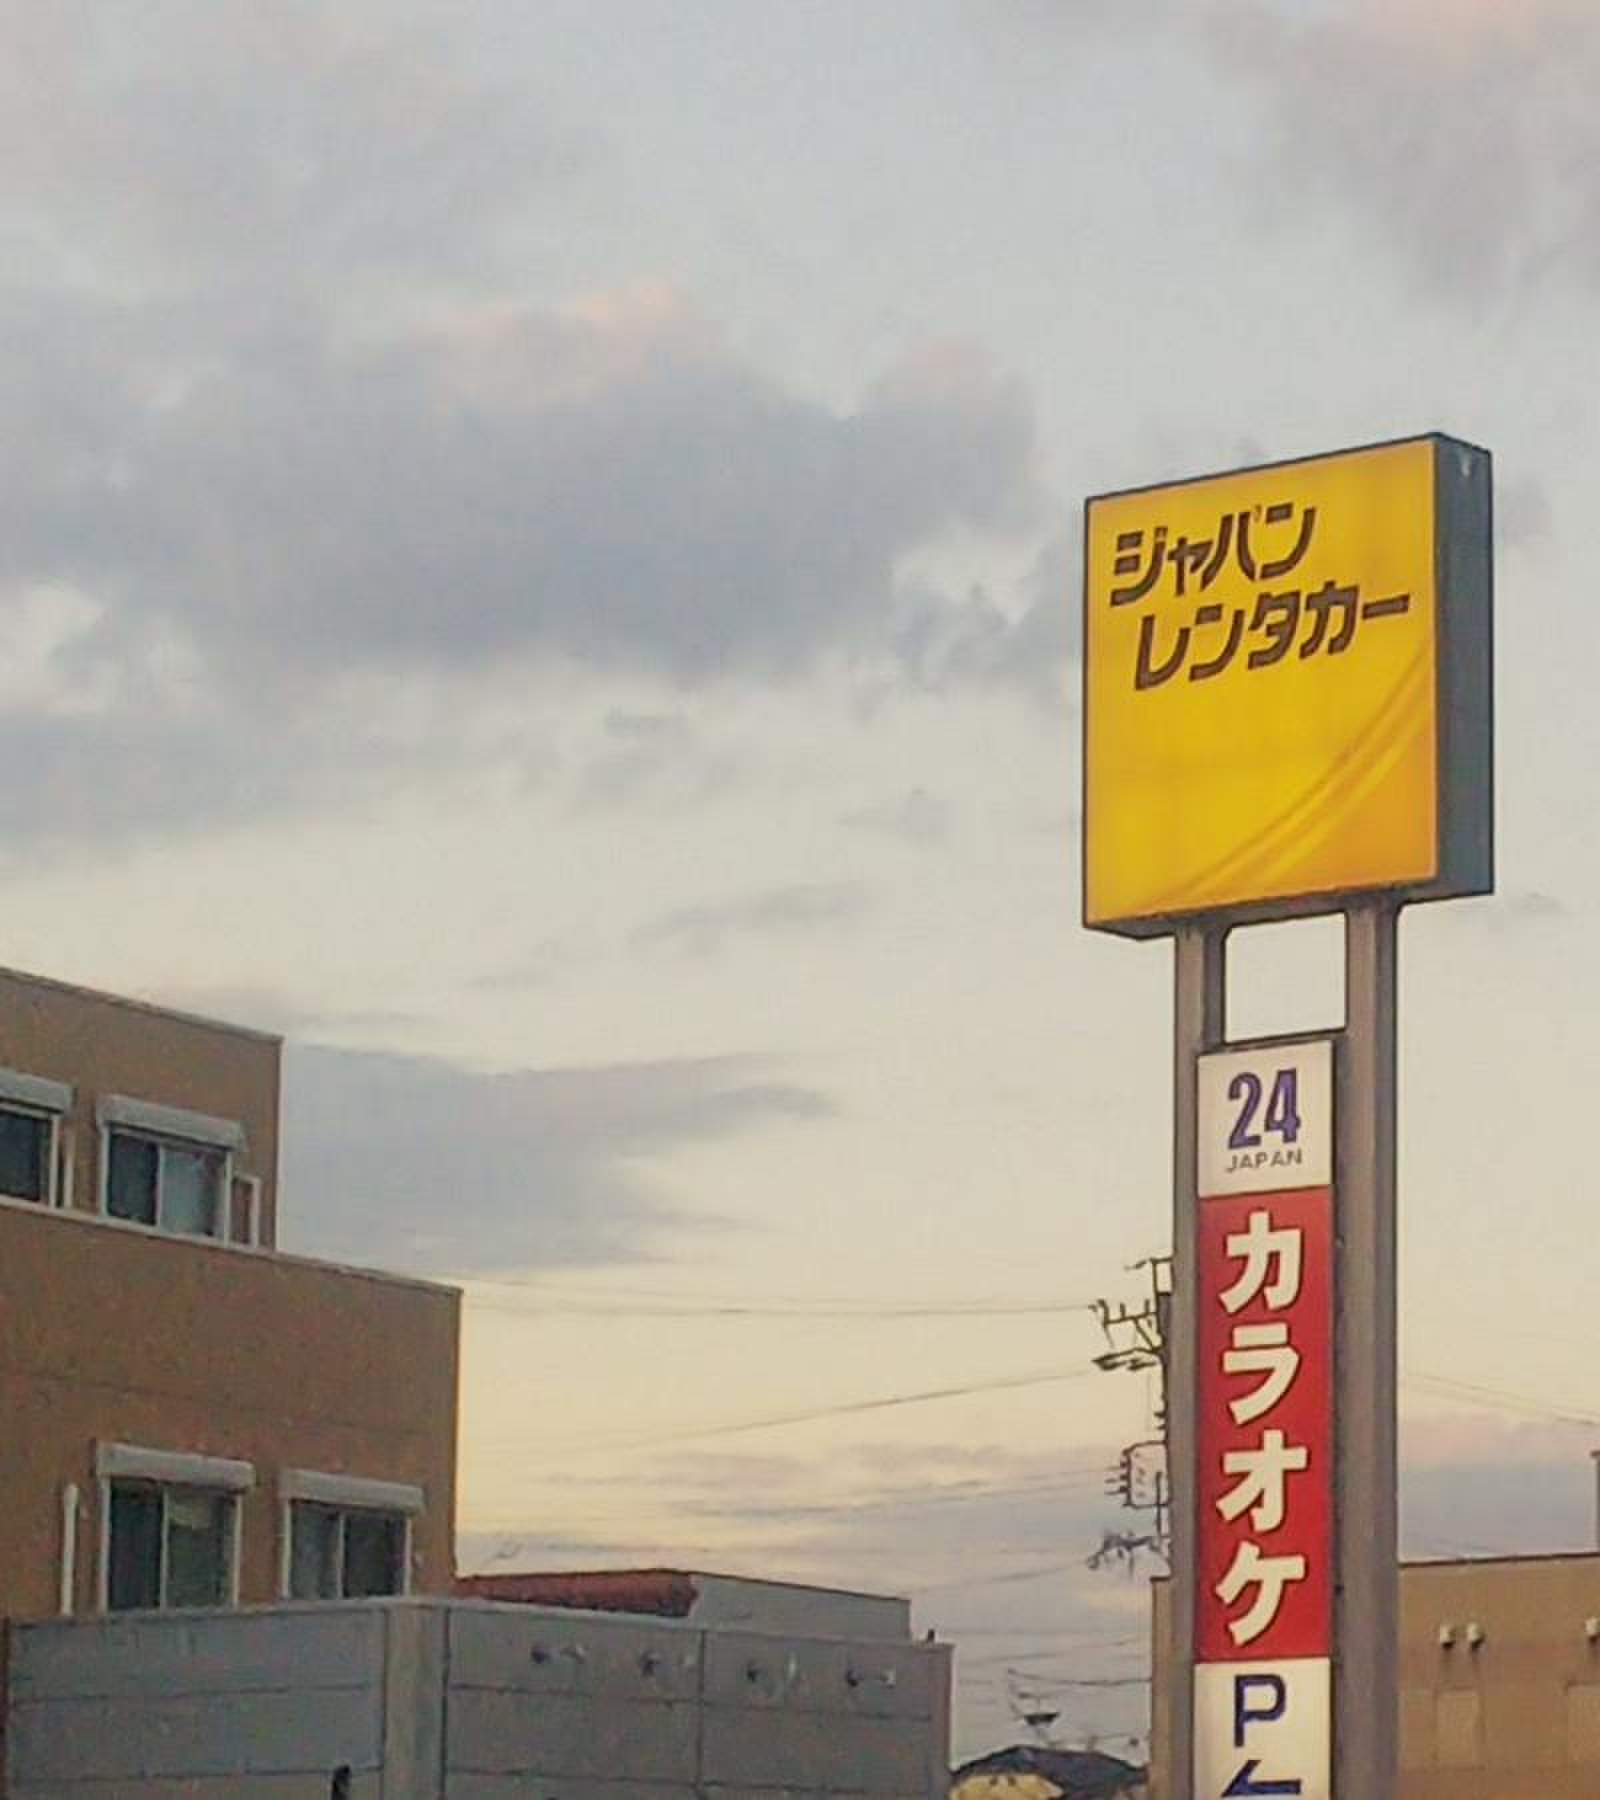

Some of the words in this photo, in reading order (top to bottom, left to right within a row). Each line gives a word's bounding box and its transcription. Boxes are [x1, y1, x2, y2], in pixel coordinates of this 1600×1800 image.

[1109, 502, 1317, 608] ジャパン
[1134, 580, 1411, 691] レンタカー
[1227, 1067, 1301, 1150] 24
[1225, 1148, 1303, 1173] JAPAN
[1214, 1207, 1309, 1647] カラオケ
[1234, 1673, 1287, 1748] P
